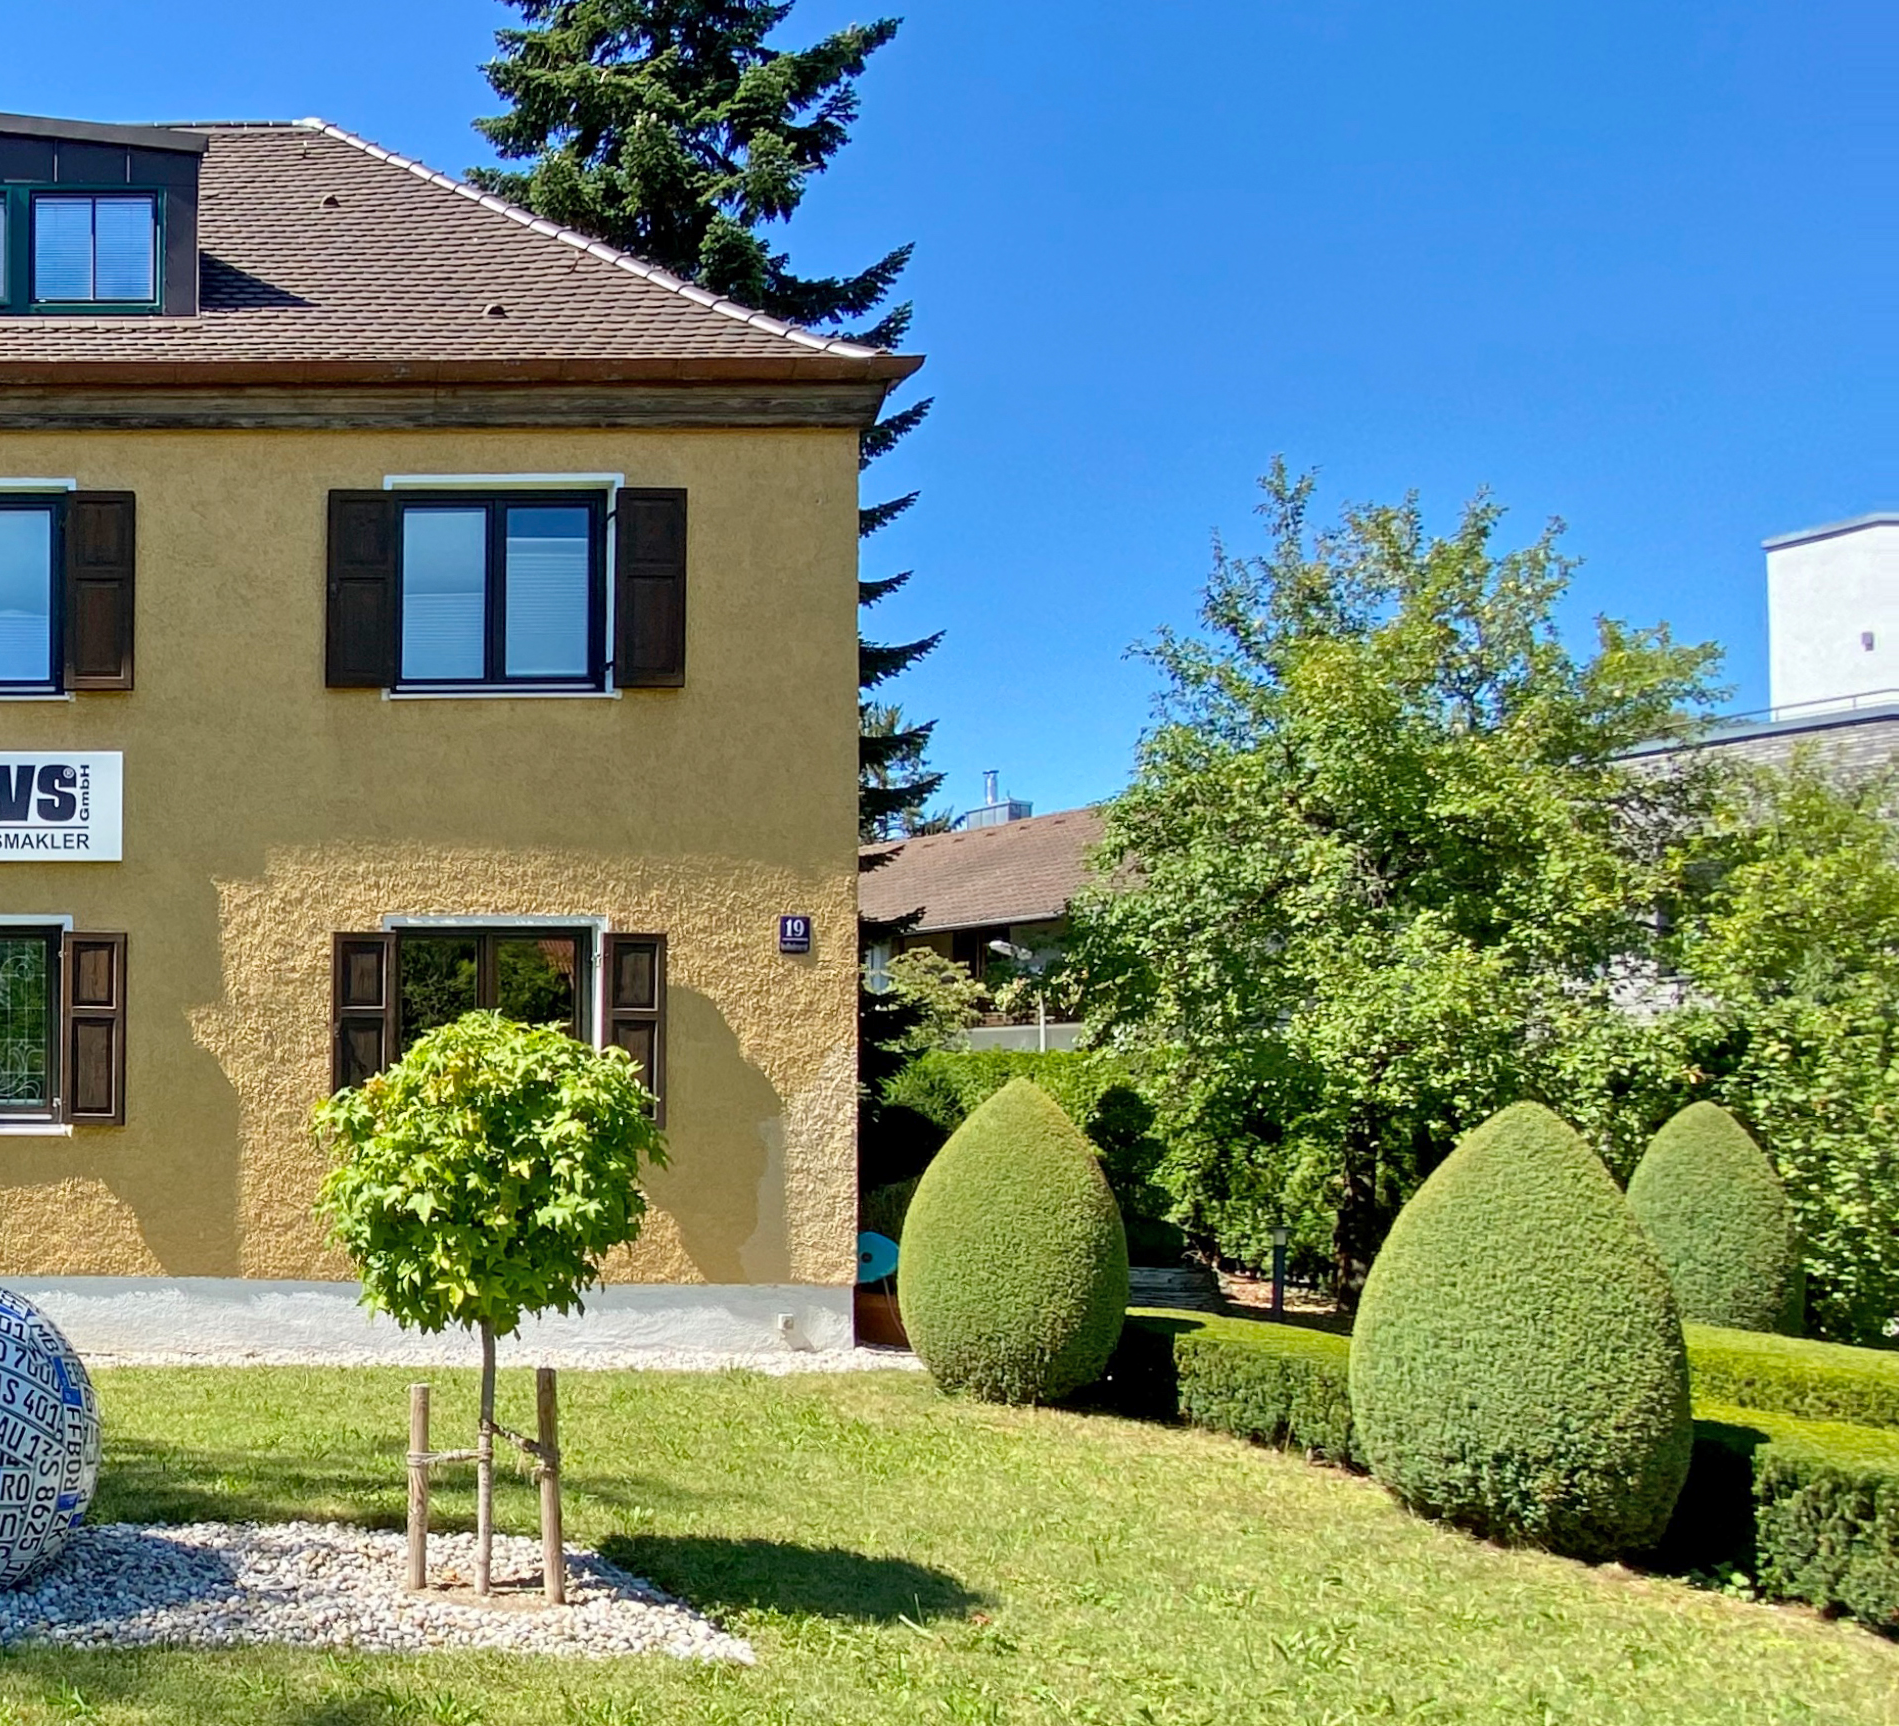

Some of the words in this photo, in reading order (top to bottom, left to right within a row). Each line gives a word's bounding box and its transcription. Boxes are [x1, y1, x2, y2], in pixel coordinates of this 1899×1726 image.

[79, 765, 91, 821] GmbH
[786, 919, 805, 937] 19
[23, 1389, 59, 1430] 401
[0, 1473, 30, 1502] RO
[18, 1485, 56, 1551] 8625
